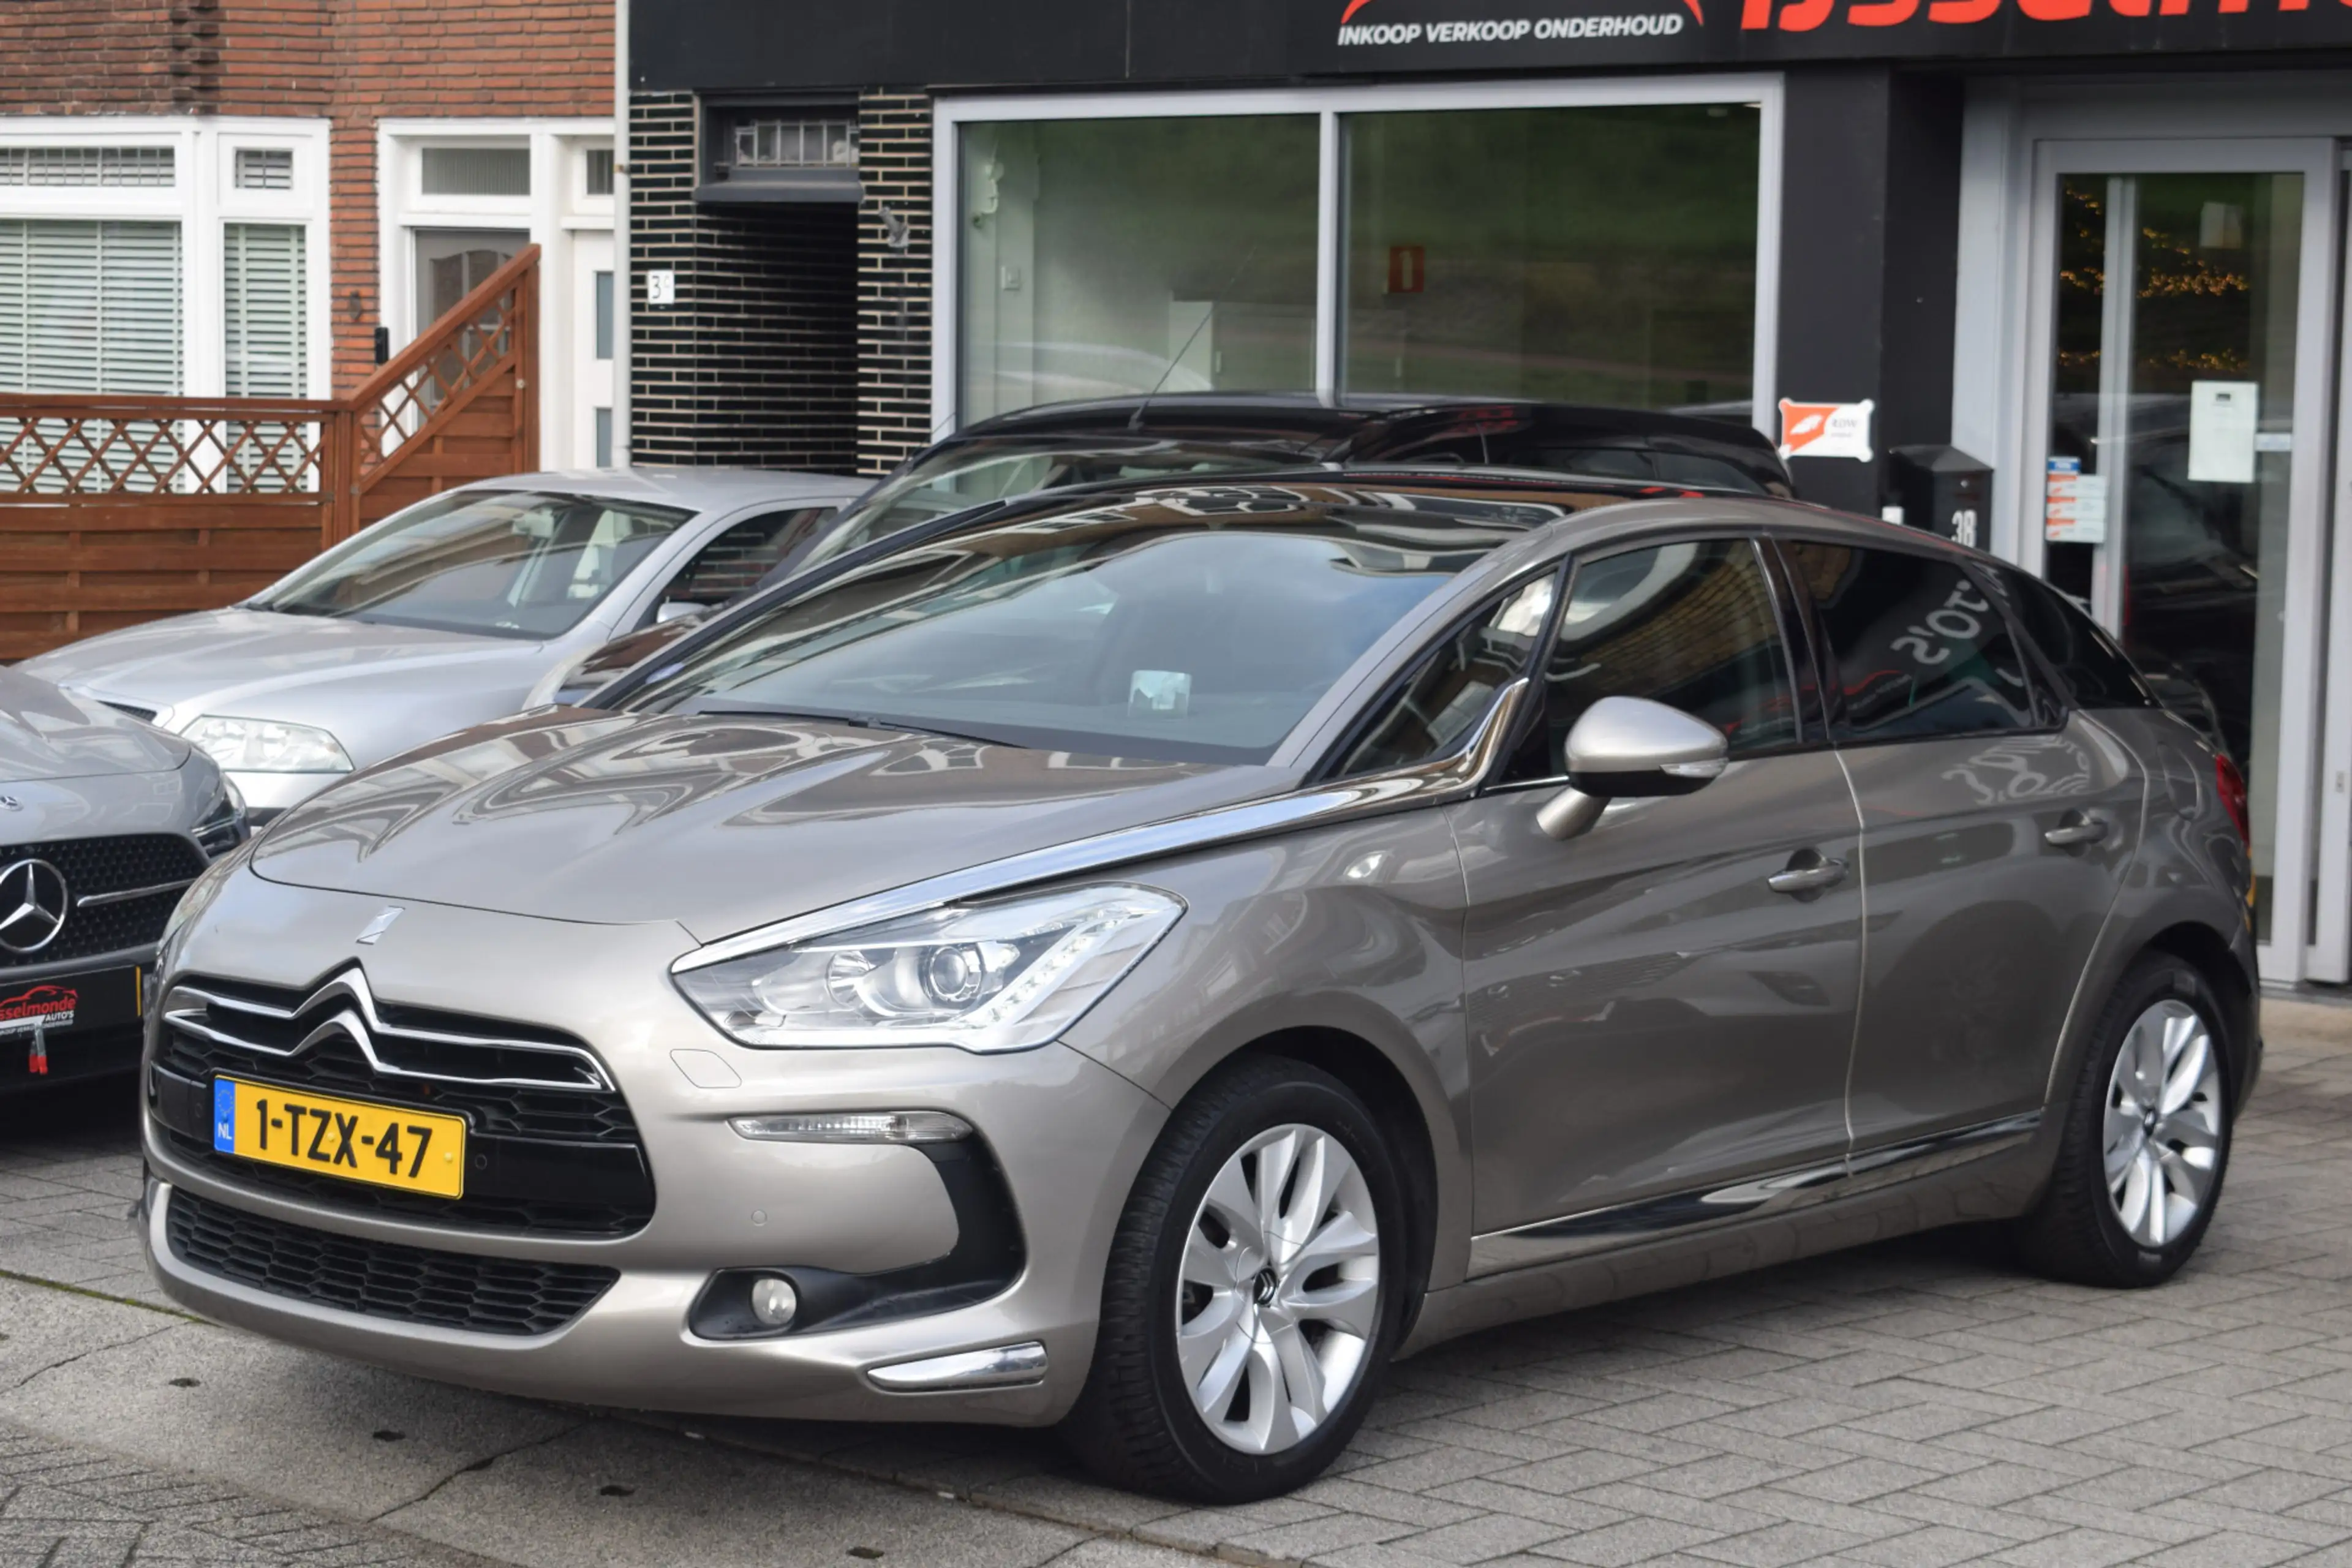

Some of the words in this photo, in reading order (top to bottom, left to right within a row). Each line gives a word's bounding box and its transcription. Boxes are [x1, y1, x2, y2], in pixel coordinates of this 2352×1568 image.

[1338, 23, 1421, 45] INKOOP
[1427, 20, 1531, 43] VERKOOP
[1534, 13, 1683, 39] ONDERHOUD
[1951, 510, 1977, 548] 38
[45, 1009, 75, 1022] AUTO'S
[218, 1122, 233, 1140] NL
[257, 1099, 433, 1178] 1-TZX-47
